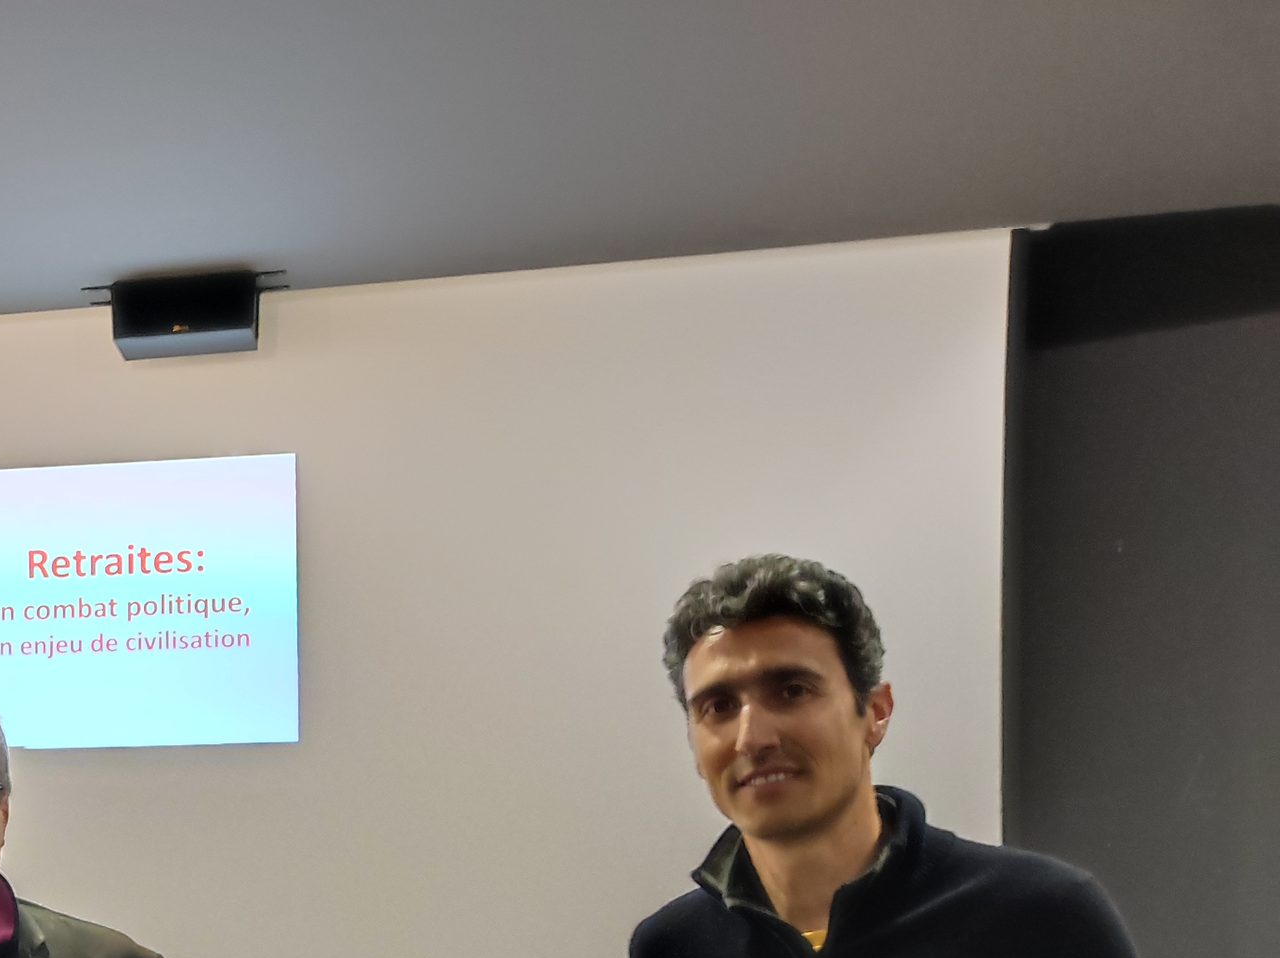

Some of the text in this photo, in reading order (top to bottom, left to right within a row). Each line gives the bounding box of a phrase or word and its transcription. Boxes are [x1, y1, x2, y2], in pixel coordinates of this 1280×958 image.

[27, 544, 205, 578] Retraites:
[23, 597, 118, 620] combat
[127, 592, 251, 621] politique,
[20, 635, 82, 659] enjeu
[90, 633, 118, 653] de
[125, 629, 251, 652] civilisation
